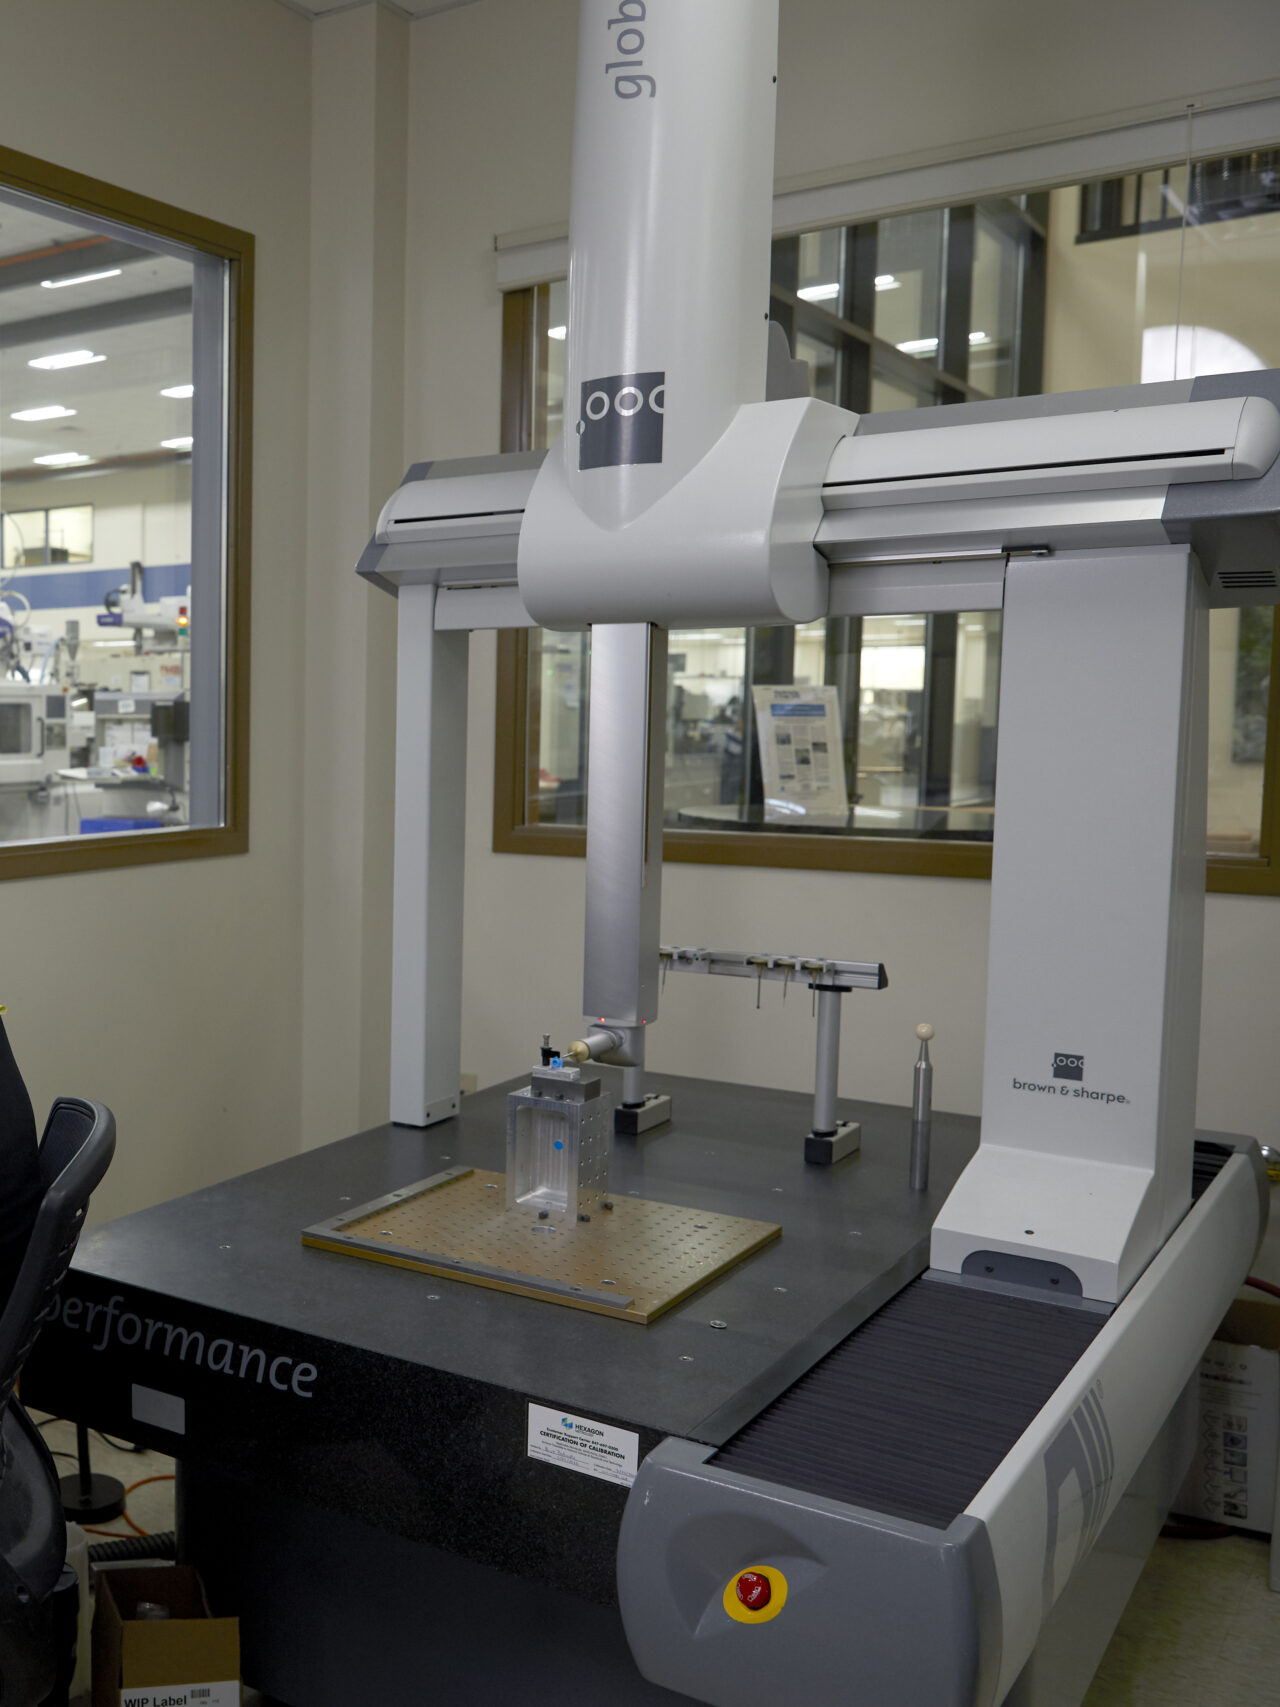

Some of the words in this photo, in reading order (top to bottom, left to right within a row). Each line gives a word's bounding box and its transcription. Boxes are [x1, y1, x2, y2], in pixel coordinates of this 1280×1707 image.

[605, 0, 657, 100] glob
[1013, 1077, 1056, 1095] brown
[1060, 1085, 1070, 1096] &
[575, 1423, 604, 1438] HEXAGON
[540, 1430, 579, 1447] CERTIFICATION
[579, 1441, 588, 1449] OF
[588, 1445, 625, 1460] CALIBRATION
[124, 1697, 149, 1707] WIP
[153, 1695, 187, 1707] Label
